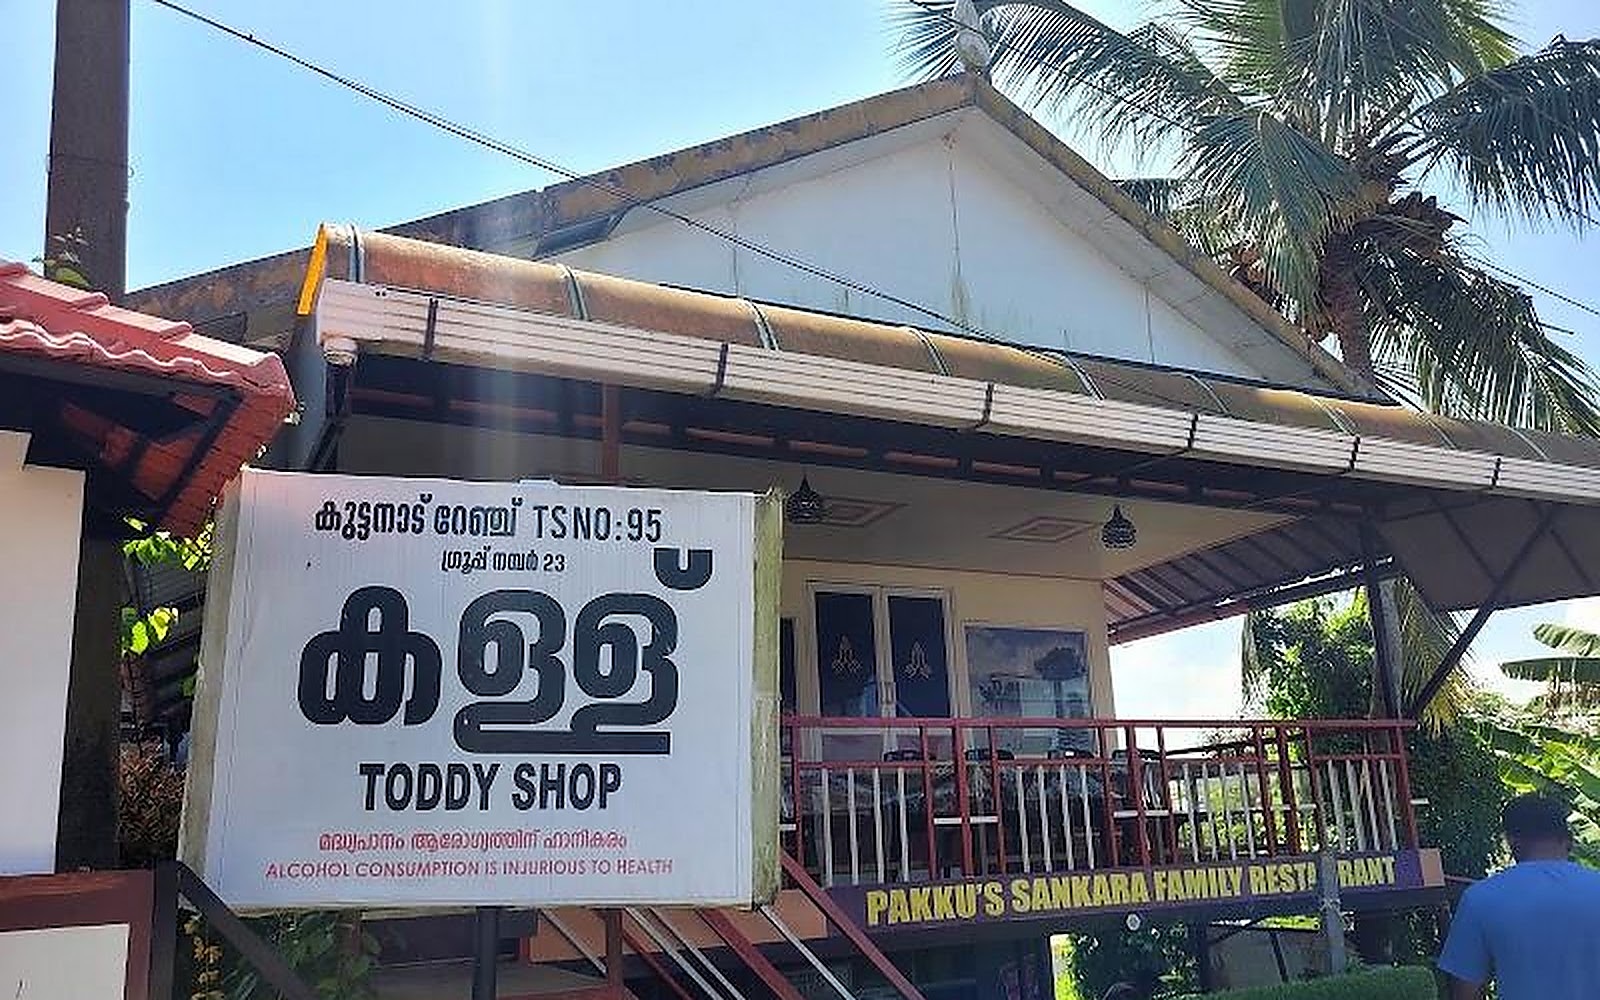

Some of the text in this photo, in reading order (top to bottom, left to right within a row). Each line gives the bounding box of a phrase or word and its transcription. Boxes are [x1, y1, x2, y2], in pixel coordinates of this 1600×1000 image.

[315, 493, 433, 541] കുട്ടനാട്
[543, 553, 566, 572] 23
[298, 547, 713, 755] കള്ള്
[359, 763, 622, 812] TODDY SHOP
[265, 859, 673, 879] ALCOHOL CONSUMPTION IS INJURIOUS TO HEALTH
[865, 856, 1396, 927] PAKKU'S SANKARA FAMILY RESTARANT
